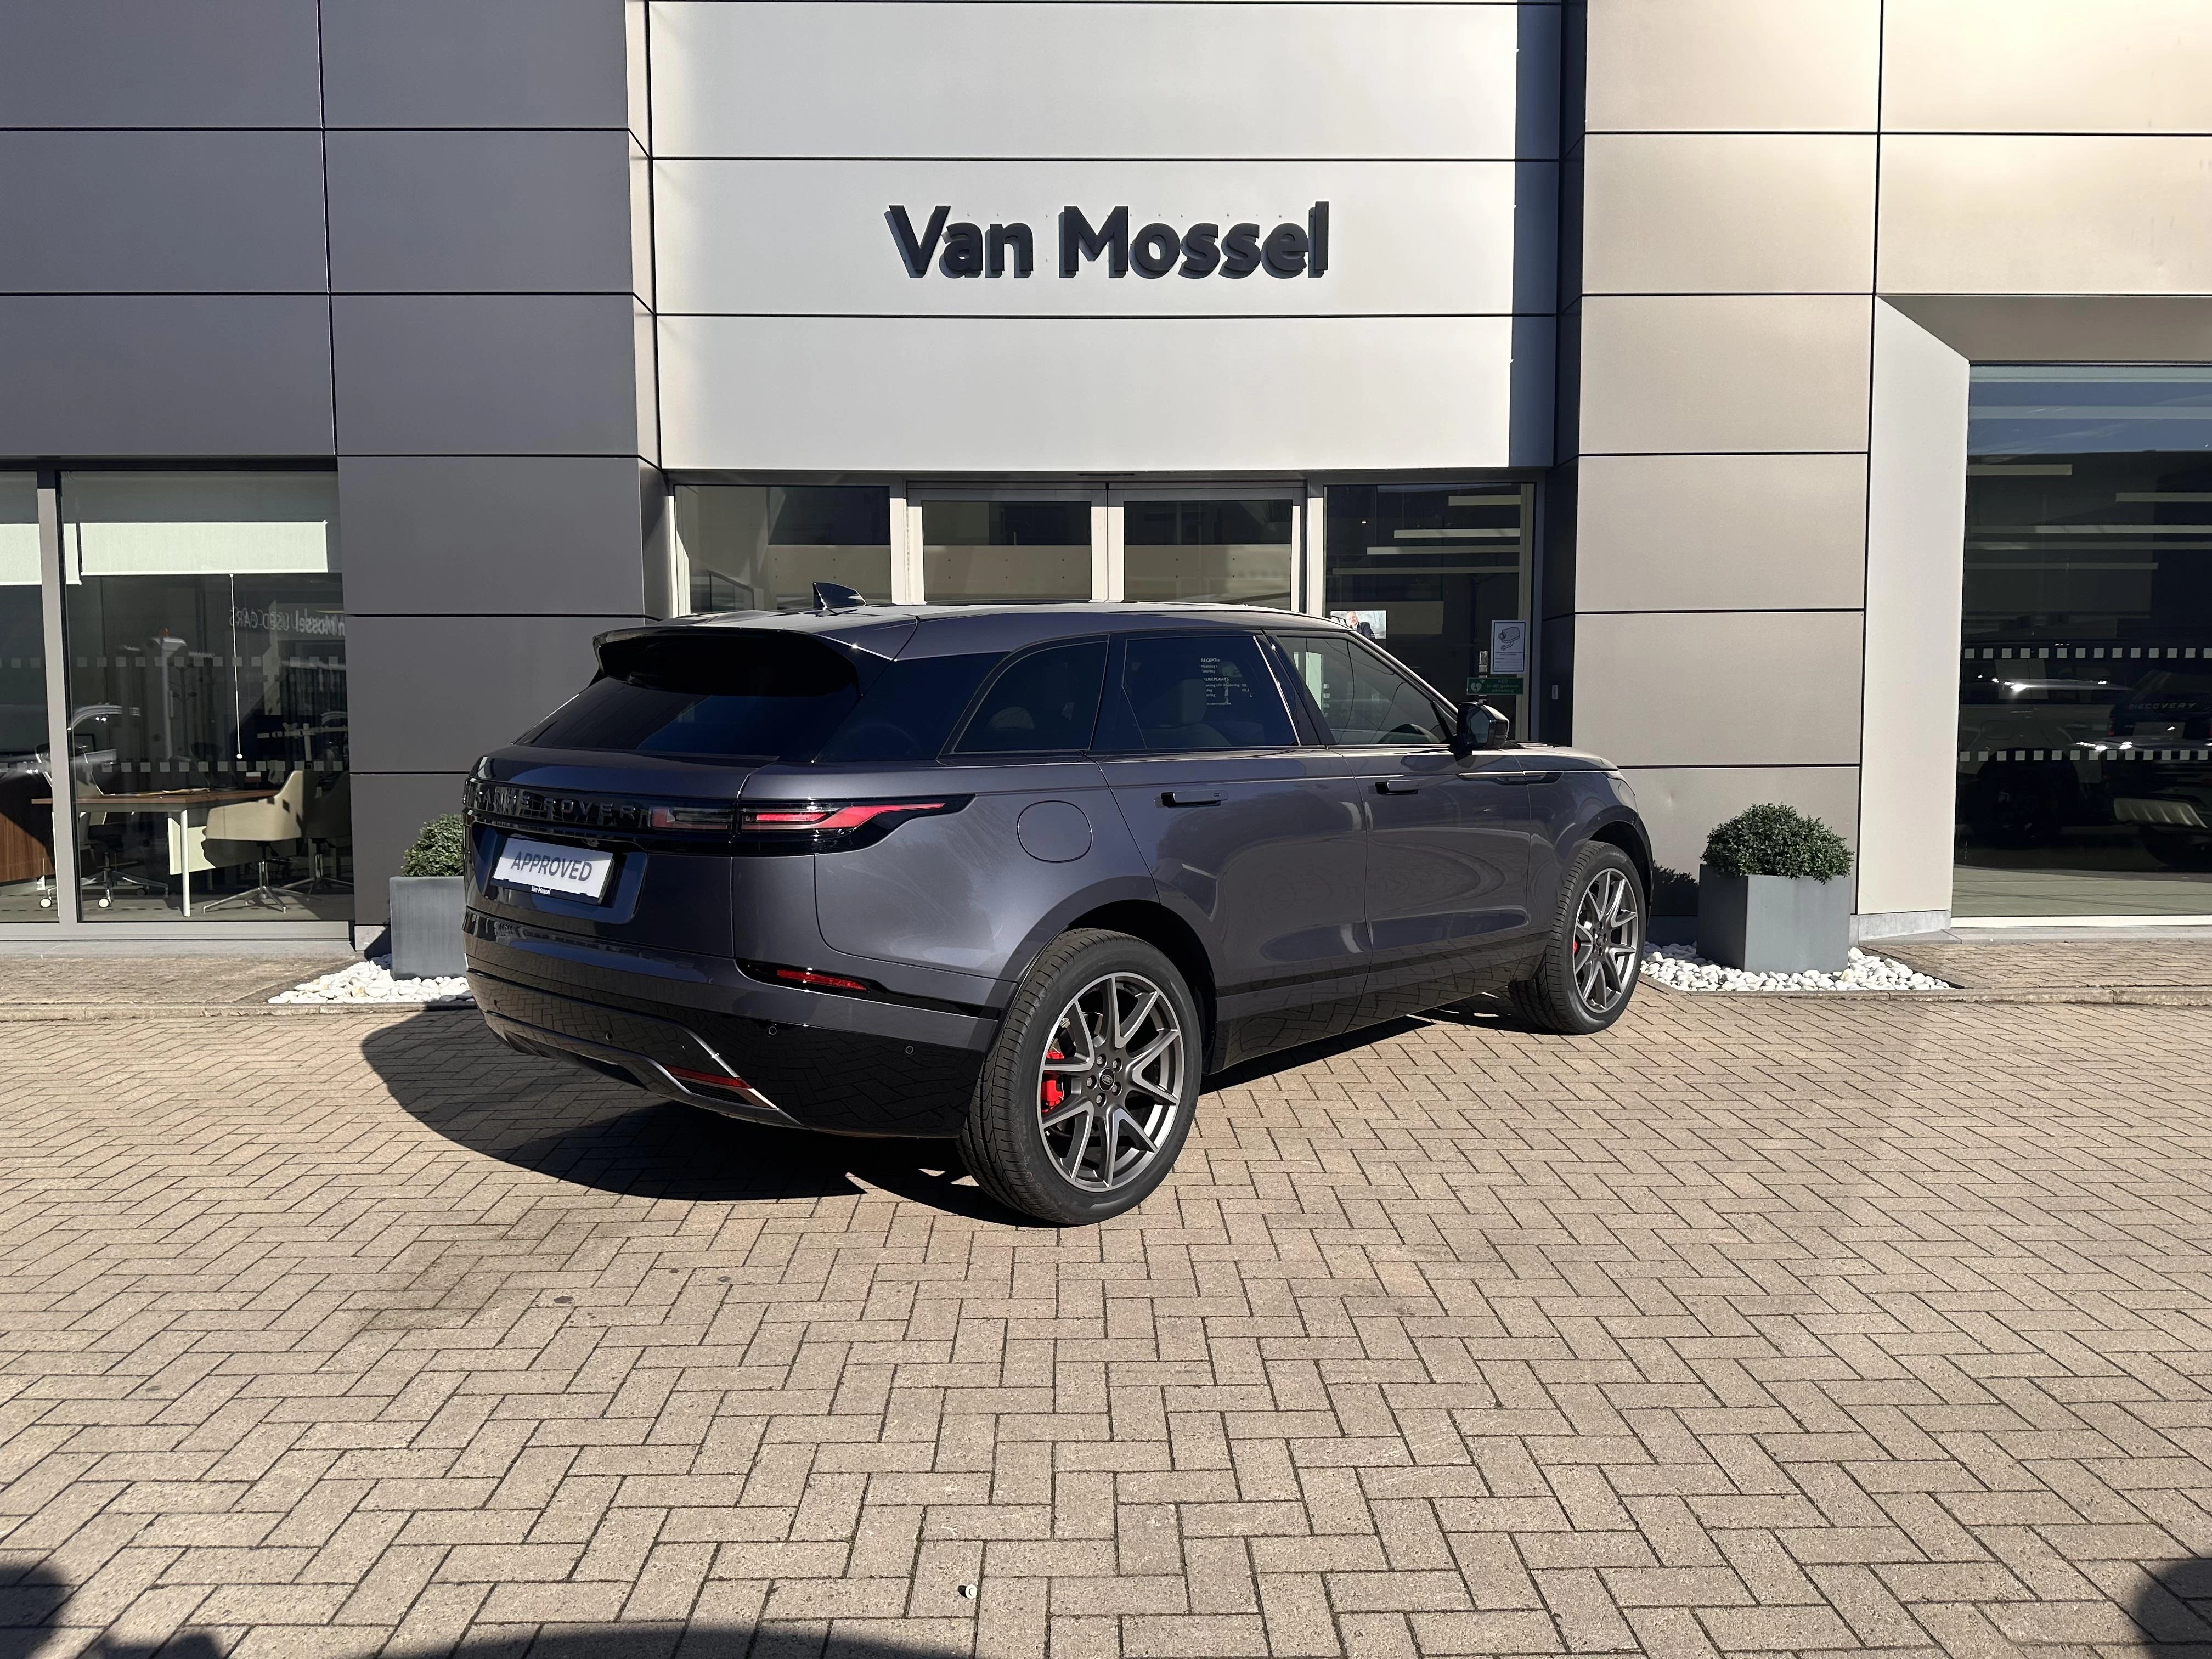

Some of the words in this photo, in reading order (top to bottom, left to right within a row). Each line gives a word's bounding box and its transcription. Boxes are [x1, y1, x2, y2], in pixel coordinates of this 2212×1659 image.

[887, 204, 1034, 275] Van
[1060, 201, 1329, 275] Mossel
[544, 798, 636, 819] ROVER
[511, 851, 592, 881] APPROVED
